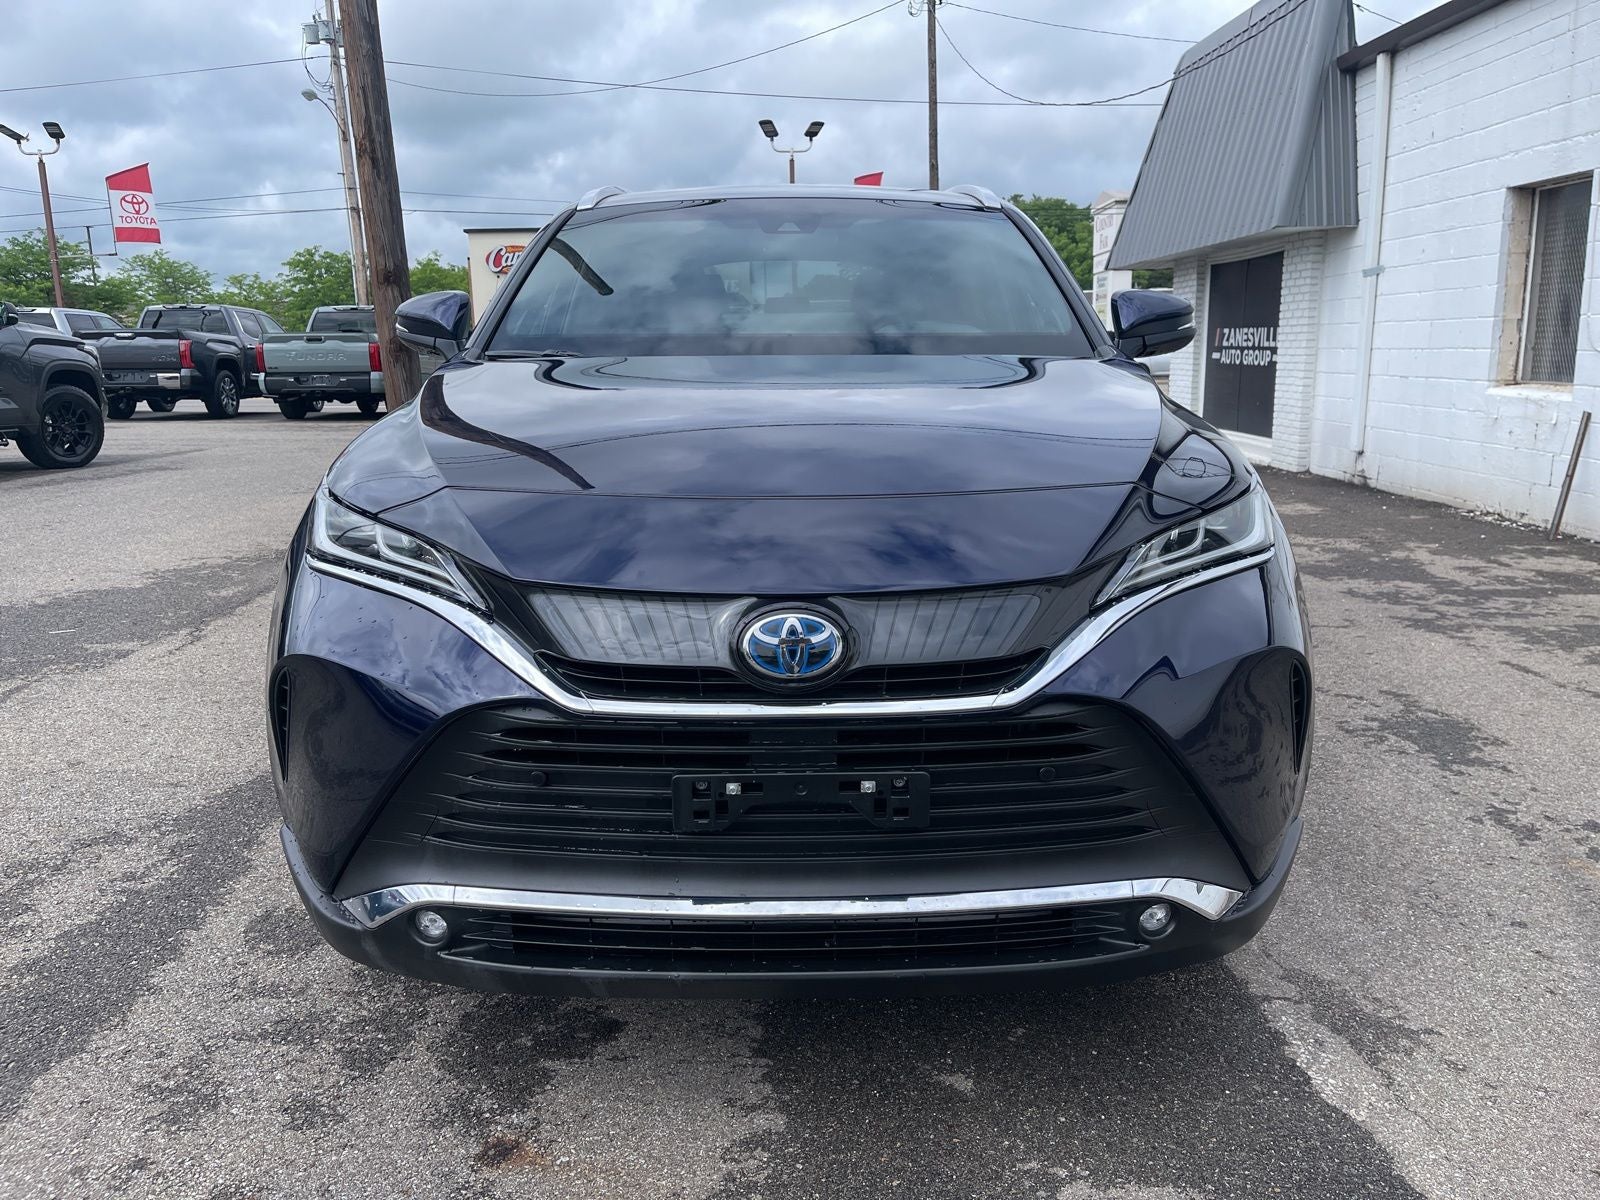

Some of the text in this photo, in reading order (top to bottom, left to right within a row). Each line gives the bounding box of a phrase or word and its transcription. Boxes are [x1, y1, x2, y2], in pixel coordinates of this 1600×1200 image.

[118, 215, 157, 225] TOYOTA
[286, 351, 347, 361] TUNDRA
[1220, 349, 1272, 366] AUTO GROUP
